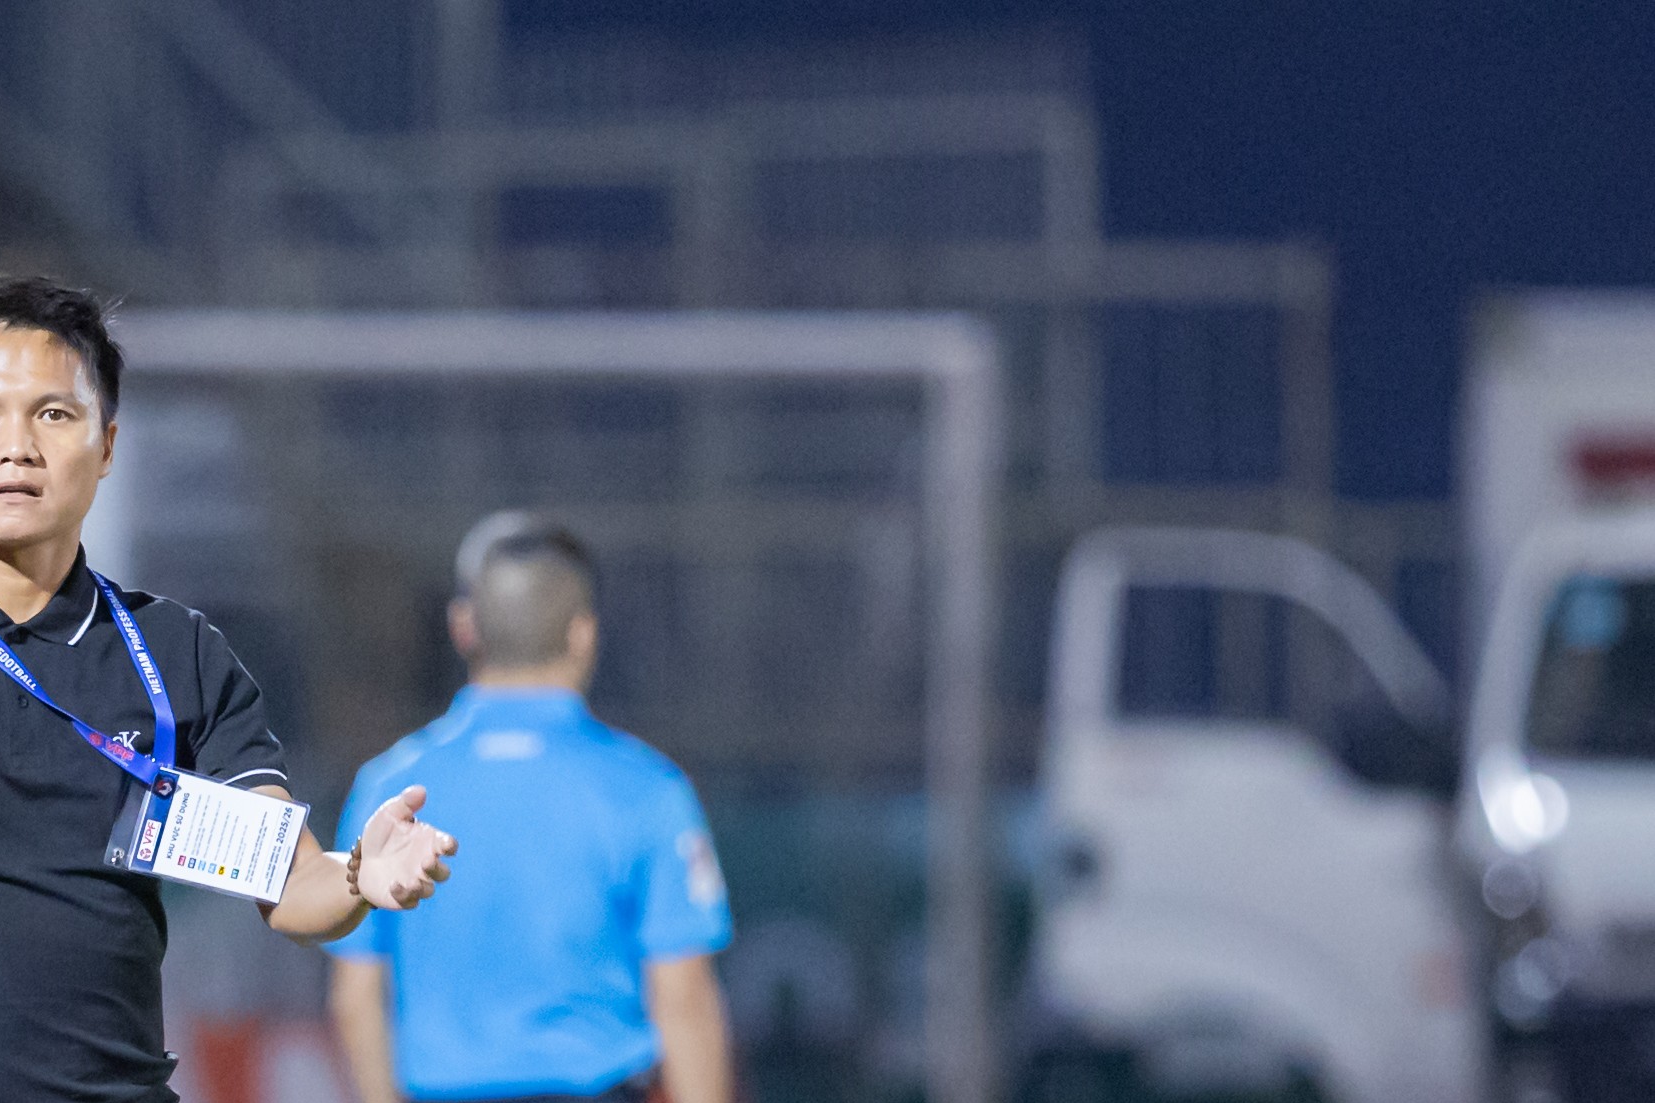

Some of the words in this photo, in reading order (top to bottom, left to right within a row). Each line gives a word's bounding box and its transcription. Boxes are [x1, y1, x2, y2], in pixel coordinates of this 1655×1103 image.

[137, 652, 162, 694] VIETNAM
[143, 822, 156, 845] VPF
[276, 806, 293, 844] 2025/26
